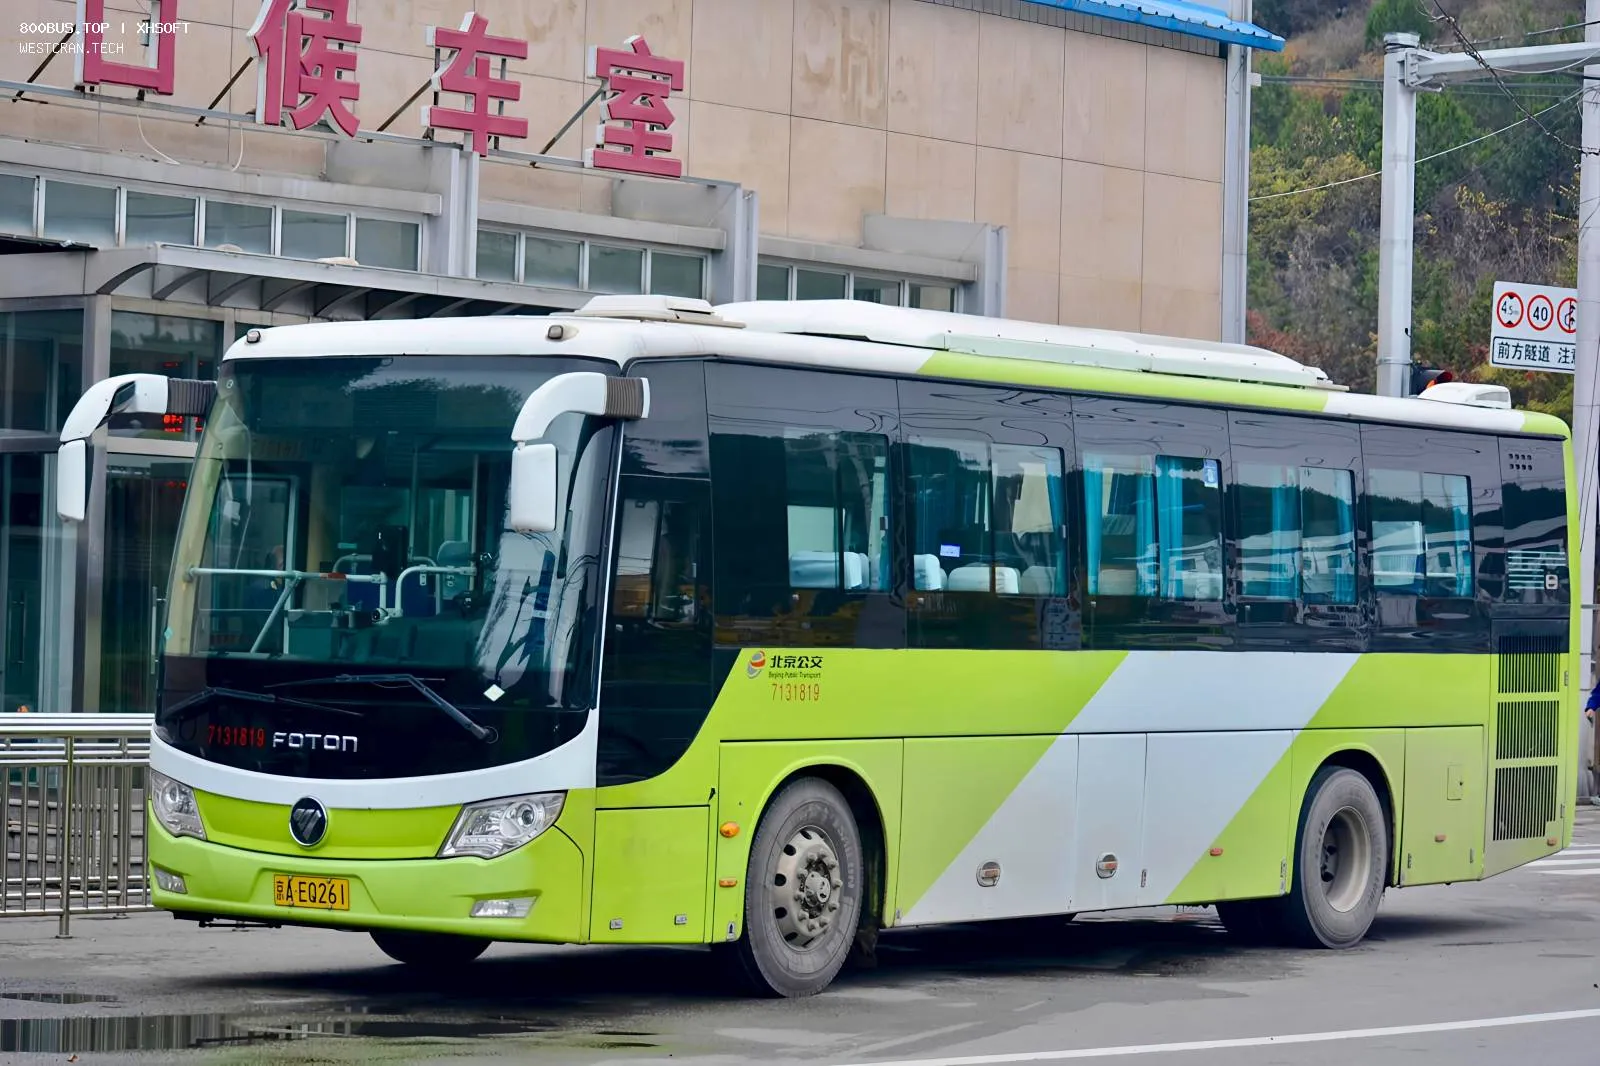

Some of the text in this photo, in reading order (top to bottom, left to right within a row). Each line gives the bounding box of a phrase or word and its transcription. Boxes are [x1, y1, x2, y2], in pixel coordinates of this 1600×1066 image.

[1533, 306, 1548, 321] 40
[1497, 341, 1550, 362] 前方隧道
[770, 655, 823, 669] 北京公交
[771, 683, 820, 701] 7131819
[207, 725, 265, 747] 7131819
[272, 732, 358, 753] FOTON
